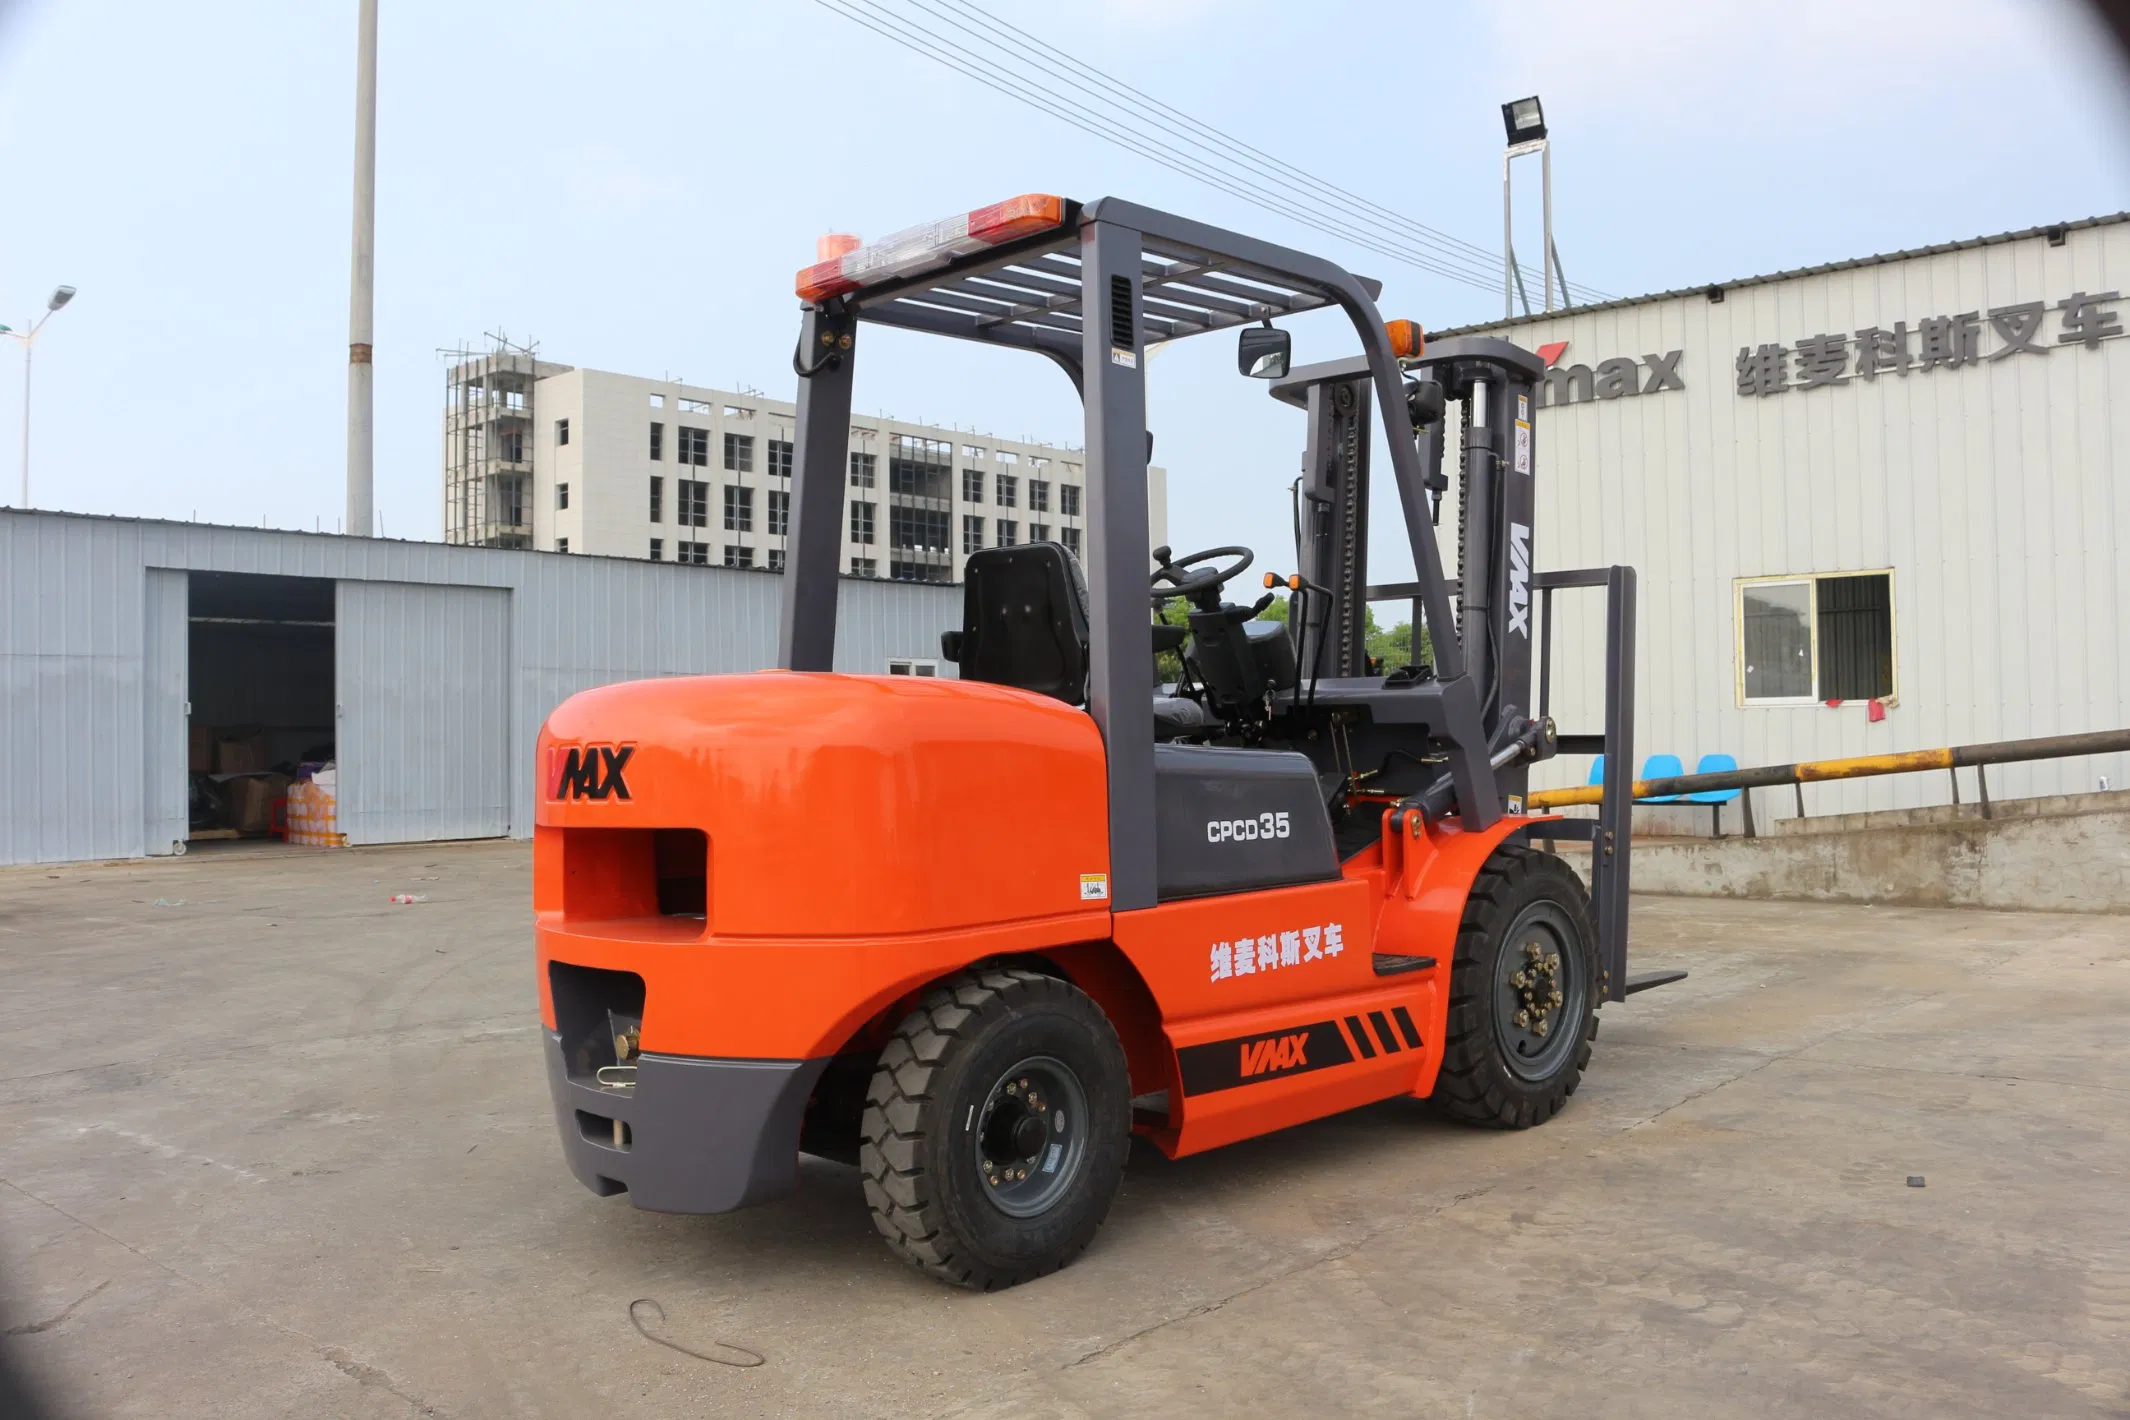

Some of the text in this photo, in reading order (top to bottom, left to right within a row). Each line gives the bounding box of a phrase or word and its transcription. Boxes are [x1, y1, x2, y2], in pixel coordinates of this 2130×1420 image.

[1735, 291, 2124, 397] 维麦科斯叉车
[1508, 522, 1530, 640] VMAX
[1210, 922, 1344, 983] 维麦科斯叉车
[1240, 1032, 1309, 1078] VMAX
